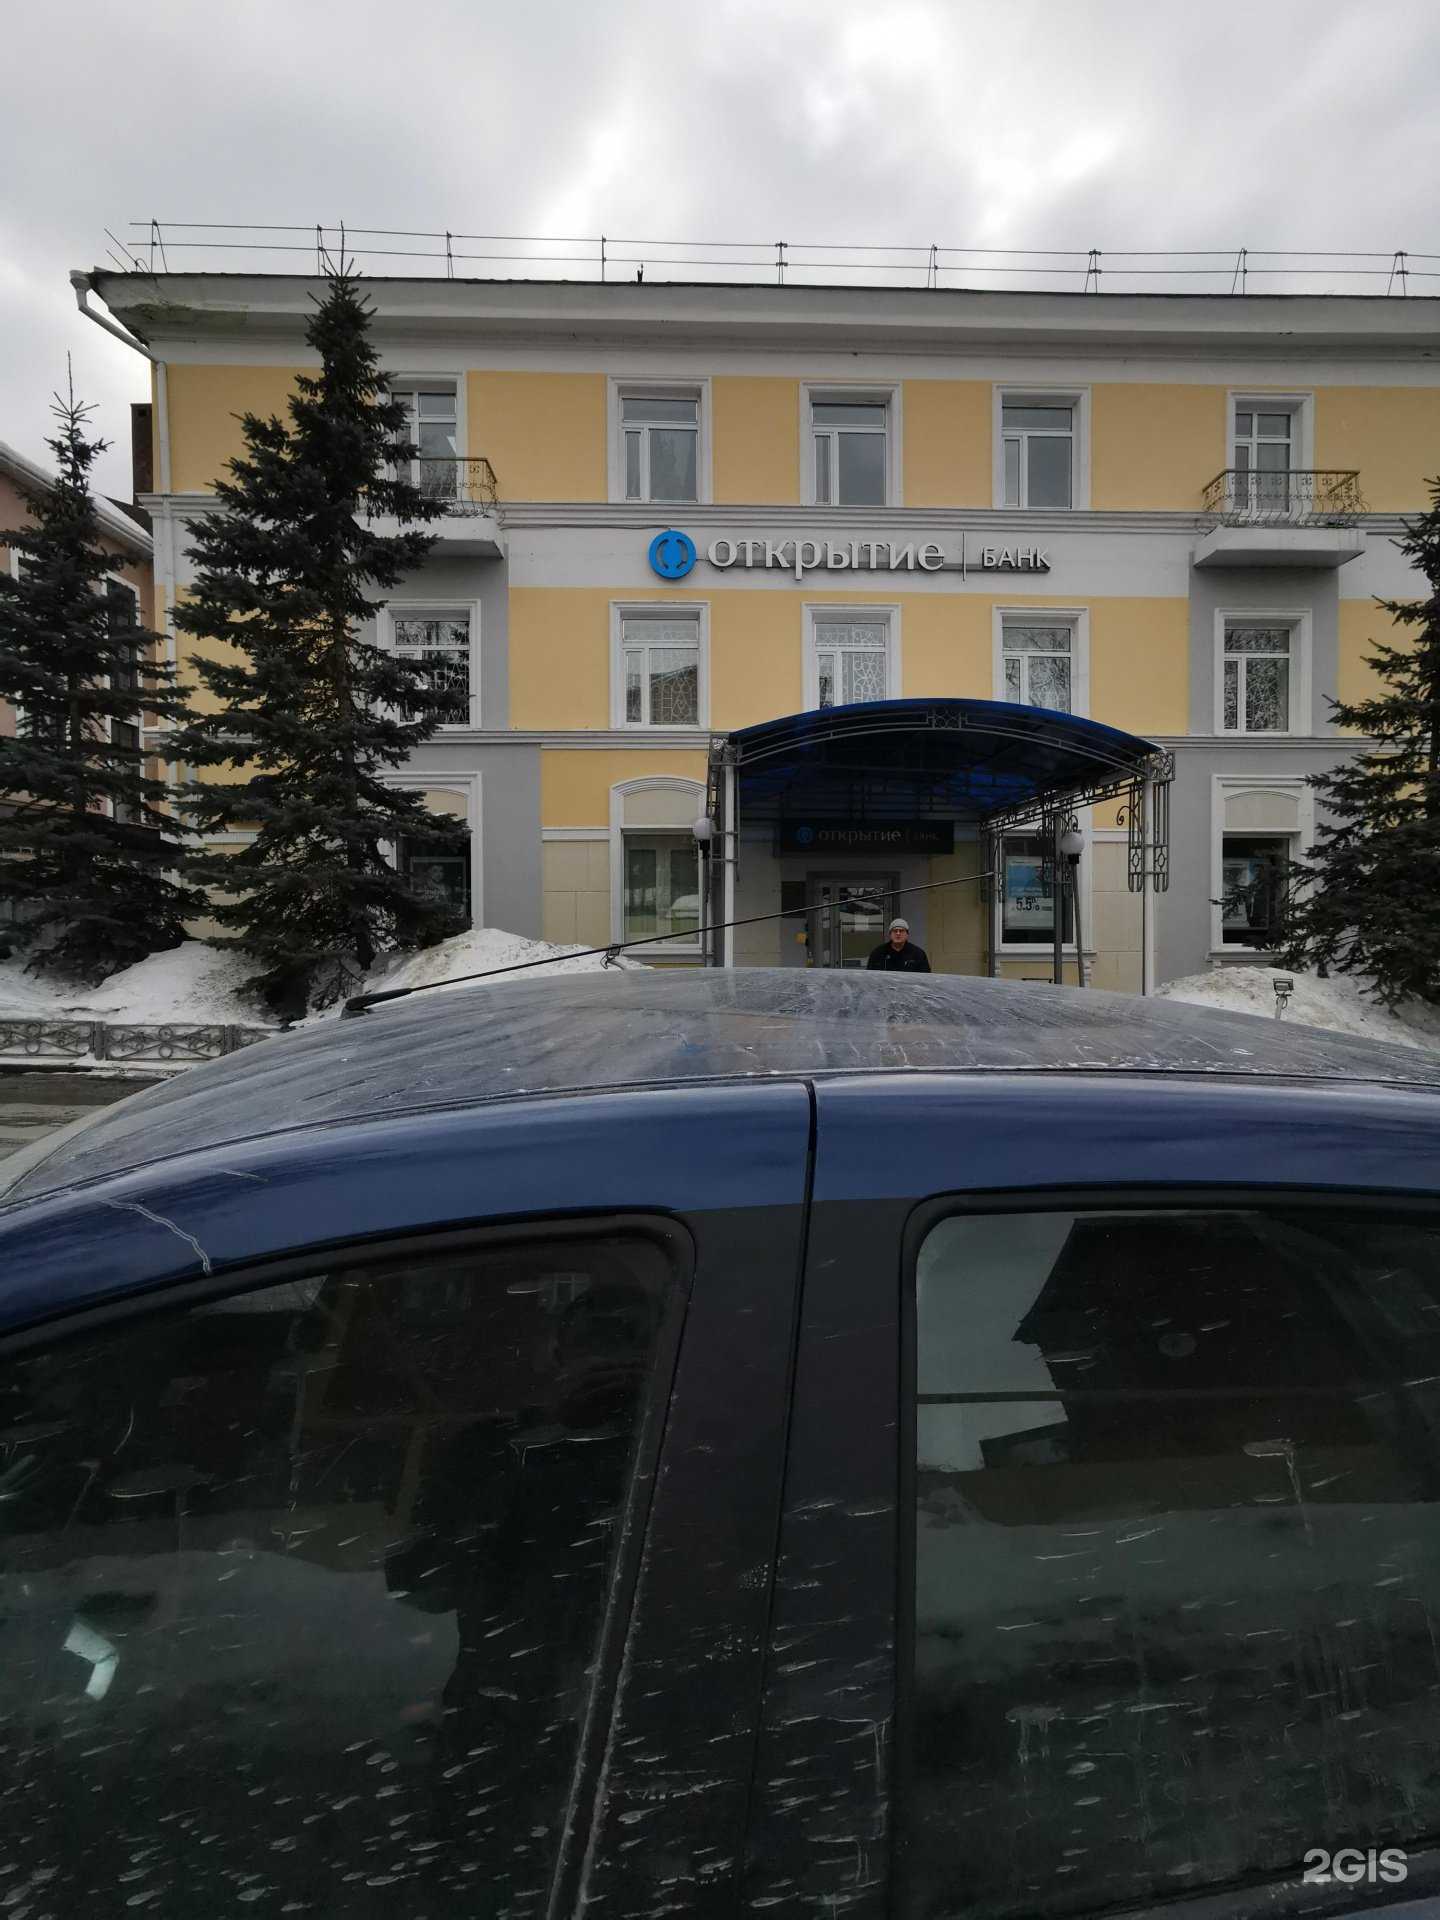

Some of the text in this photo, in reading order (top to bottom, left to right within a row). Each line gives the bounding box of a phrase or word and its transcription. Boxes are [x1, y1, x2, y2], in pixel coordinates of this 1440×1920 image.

[707, 538, 1051, 581] открытие БАНК
[817, 828, 902, 845] открытие
